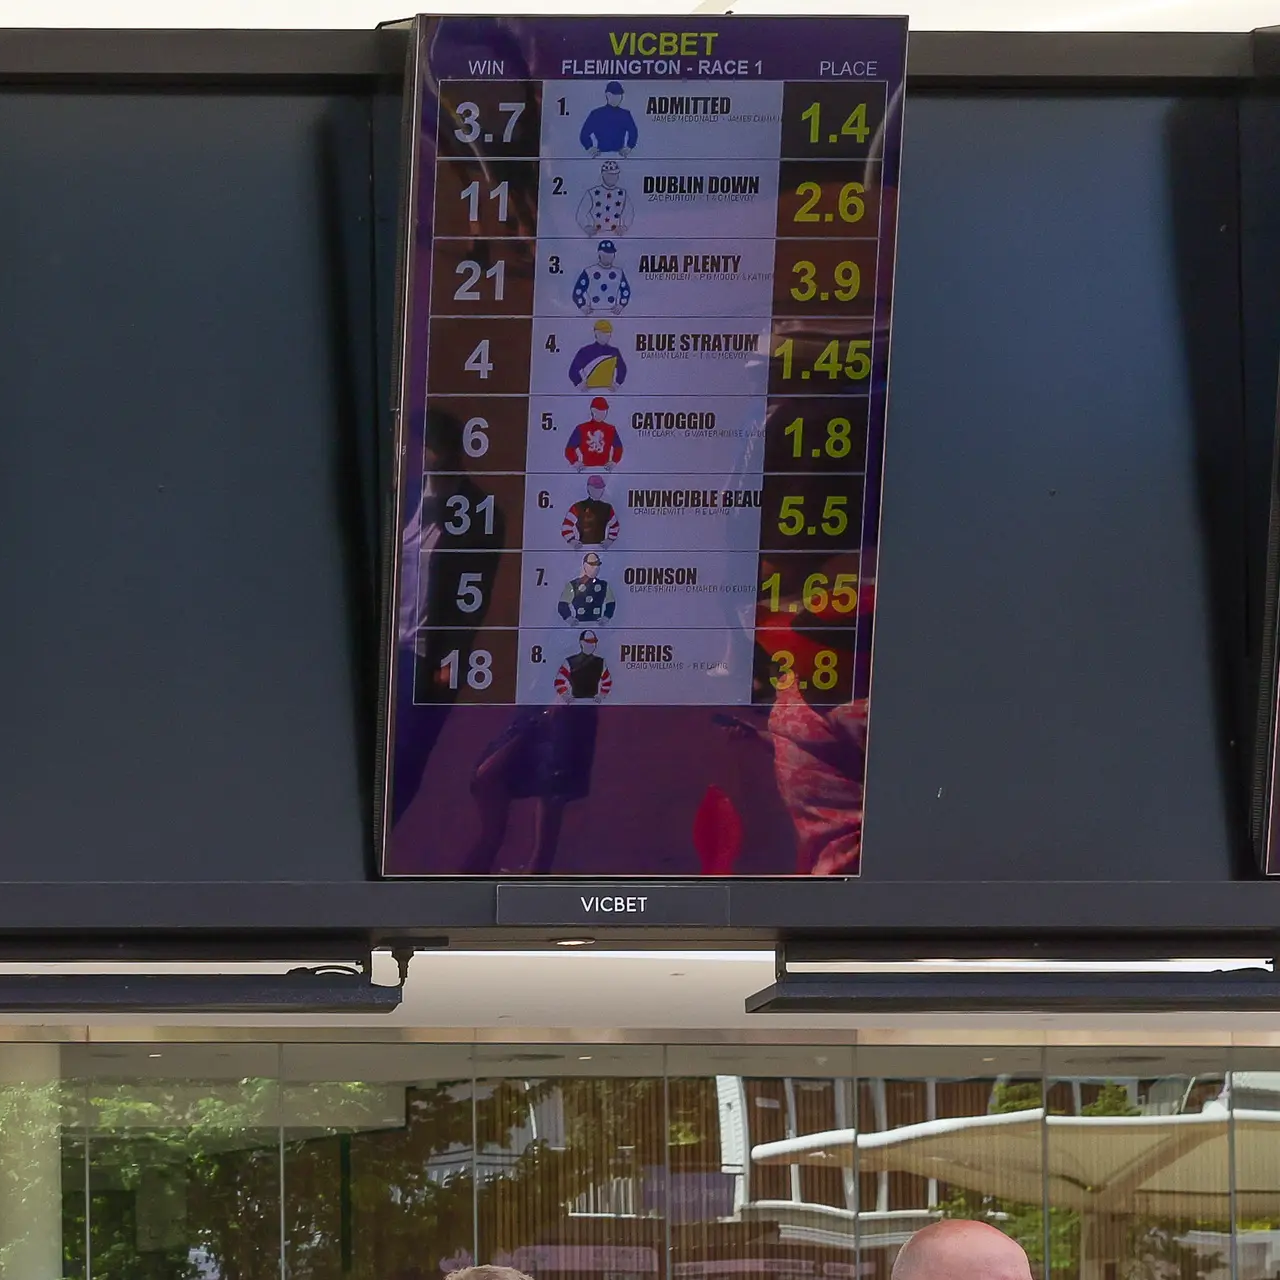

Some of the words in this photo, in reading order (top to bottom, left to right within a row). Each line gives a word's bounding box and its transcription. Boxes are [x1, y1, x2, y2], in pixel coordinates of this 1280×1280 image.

[609, 32, 718, 56] VICBET
[468, 60, 504, 76] WIN
[562, 60, 680, 76] FLEMINGTON
[698, 60, 749, 75] RACE
[755, 61, 763, 75] 1
[820, 61, 877, 77] PLACE
[646, 96, 731, 115] ADMITTED
[802, 102, 869, 143] 1.4
[643, 176, 703, 194] DUBLIN
[708, 176, 759, 194] DOWN
[640, 255, 678, 273] ALAA
[683, 255, 741, 273] PLENTY
[636, 334, 675, 352] BLUE
[679, 334, 759, 352] STRATUM
[631, 412, 715, 430] CATOGGIO
[628, 489, 718, 508] INVINCIBLE
[723, 490, 762, 508] BEAU
[624, 568, 697, 586] ODINSON
[620, 645, 672, 663] PIERIS
[581, 897, 647, 912] VICBET
